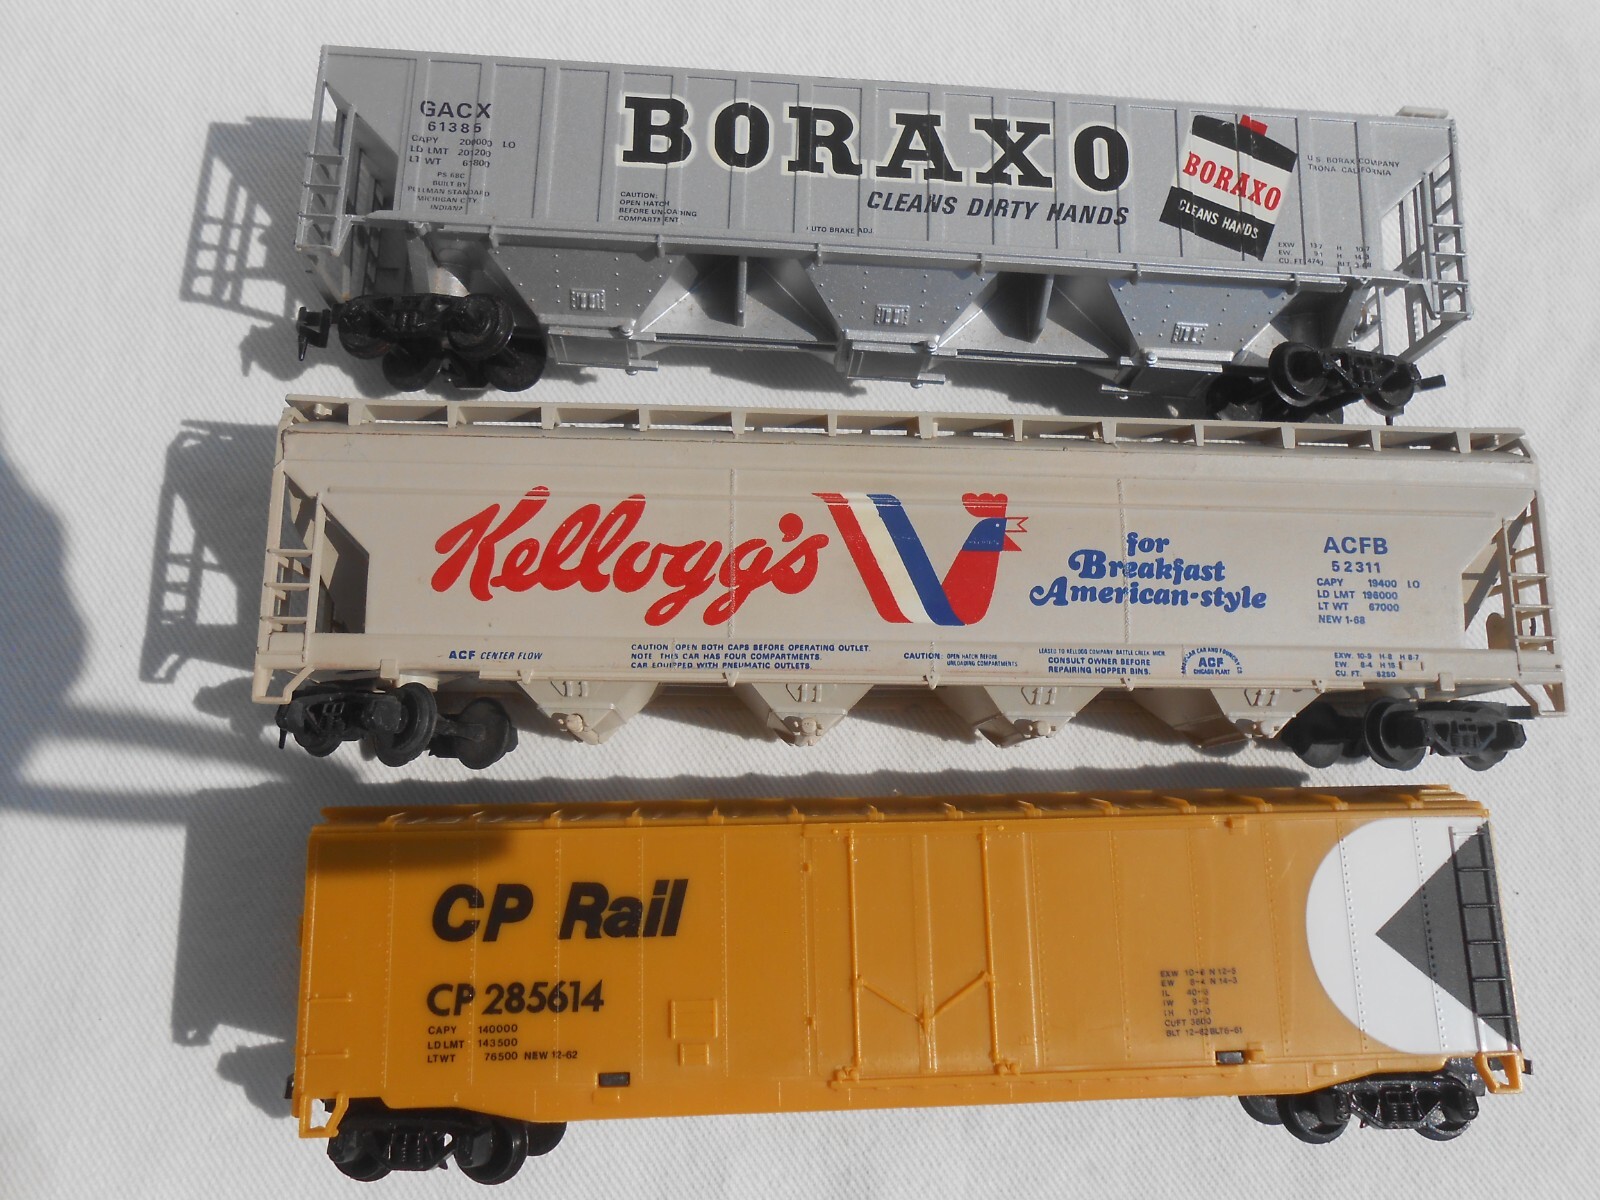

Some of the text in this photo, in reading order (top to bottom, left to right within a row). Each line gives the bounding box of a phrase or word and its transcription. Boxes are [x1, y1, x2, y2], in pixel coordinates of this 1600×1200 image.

[420, 100, 492, 119] GACX
[427, 121, 482, 134] 61385
[411, 134, 439, 144] CAPY
[502, 141, 516, 149] LO
[618, 95, 1132, 195] BORAXO
[410, 145, 424, 153] LD
[427, 147, 449, 155] LMT
[424, 158, 442, 166] WT
[1326, 157, 1355, 165] BORAX
[1358, 157, 1400, 168] COMPANY
[1183, 151, 1282, 211] BORAXO
[619, 207, 648, 215] BEFORE
[867, 191, 1129, 225] CLEANS DIRTY HANDS
[1178, 199, 1259, 239] CLEANS HANDS
[829, 226, 855, 234] BRAKE
[1126, 532, 1170, 557] for
[1323, 536, 1389, 555] ACFB
[430, 485, 830, 627] Kellogg's
[1067, 548, 1226, 586] Breakfast
[1331, 560, 1381, 574] 52311
[1316, 578, 1421, 589] CAPY 19400 LO
[1029, 576, 1267, 613] American-style
[1317, 590, 1330, 599] LD
[1333, 591, 1356, 599] LMT
[1318, 602, 1400, 612] LT WT 67000
[1318, 615, 1366, 625] NEW 1-68
[788, 644, 835, 652] OPERATING
[449, 650, 543, 660] ACF CENTER FLOW
[1048, 656, 1151, 666] CONSULT OWNER BEFORE
[1198, 656, 1224, 668] ACF
[1048, 665, 1151, 675] REPAIRING HOPPER BINS.
[431, 878, 689, 942] CP Rail
[426, 979, 605, 1017] CP 285614
[428, 1024, 518, 1035] CAPY 140000
[427, 1038, 518, 1049] LD LMT 143500
[485, 1051, 518, 1061] 76500
[524, 1051, 548, 1060] NEW
[552, 1050, 578, 1060] 12-62
